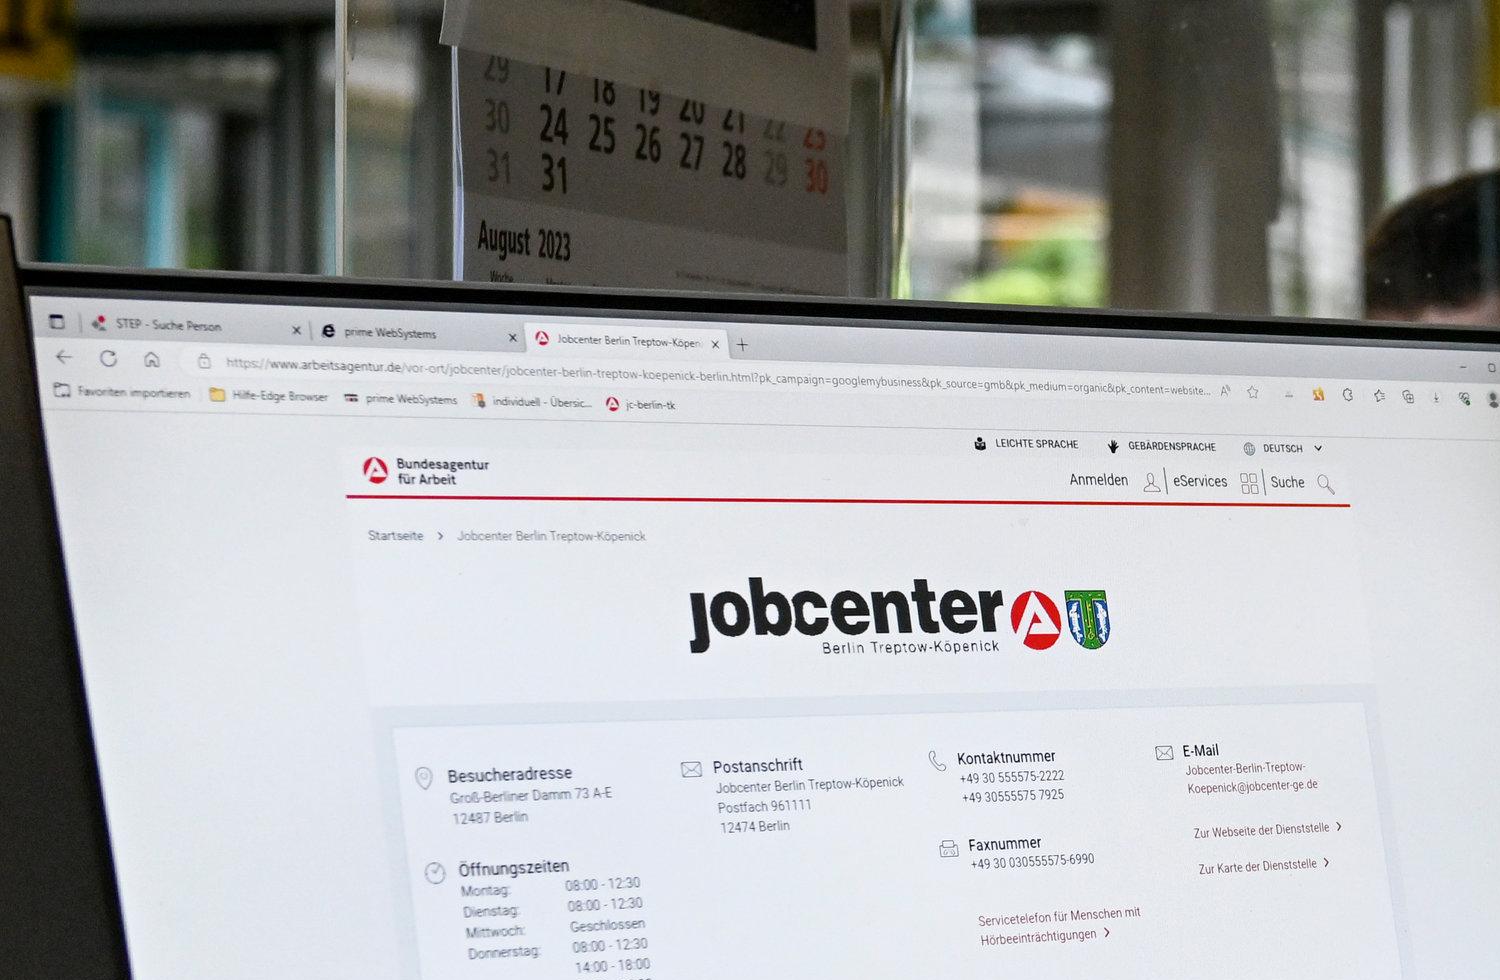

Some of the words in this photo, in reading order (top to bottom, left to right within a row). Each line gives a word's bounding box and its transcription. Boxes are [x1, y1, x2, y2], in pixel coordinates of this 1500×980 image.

[593, 78, 615, 106] 18
[485, 98, 509, 135] 30
[540, 103, 568, 145] 24
[589, 113, 616, 154] 25
[635, 123, 661, 163] 26
[680, 133, 704, 171] 27
[723, 141, 747, 181] 28
[764, 150, 788, 187] 29
[805, 157, 829, 194] 30
[488, 148, 511, 185] 31
[542, 153, 568, 194] 31
[478, 220, 530, 261] August
[539, 229, 571, 261] 2023
[116, 318, 141, 329] STEP
[153, 320, 183, 332] Suche
[186, 322, 222, 333] Person
[345, 326, 373, 338] prime
[376, 327, 437, 342] WebSystems
[558, 333, 601, 345] Jobcenter
[605, 335, 630, 346] Berlin
[78, 386, 127, 398] Favoriten
[130, 388, 191, 401] importieren
[233, 389, 287, 403] Hilfe-Edge
[289, 391, 328, 402] Browser
[367, 394, 393, 406] prime
[396, 394, 457, 407] WebSystems
[626, 400, 675, 412] jc-berlin-tk
[996, 438, 1034, 448] LEICHTE
[1036, 438, 1079, 449] SPRACHE
[1128, 439, 1216, 452] GEBÄRDENSPRACHE
[1264, 443, 1303, 453] DEUTSCH
[397, 458, 490, 471] Bundesagentur
[398, 473, 416, 485] für
[420, 474, 456, 485] Arbeit
[1069, 473, 1129, 486] Anmelden
[1174, 475, 1228, 488] eServices
[1271, 476, 1305, 489] Suche
[368, 529, 424, 541] Startseite
[457, 530, 513, 541] Jobcenter
[516, 530, 547, 541] Berlin
[550, 530, 646, 544] Treptow-Köpenick
[690, 577, 1003, 654] jobcenter
[822, 641, 865, 655] Berlin
[870, 640, 1000, 656] Treptow-Köpenick
[957, 750, 1056, 765] Kontaktnummer
[1183, 743, 1219, 757] E-Mail
[713, 757, 803, 774] Postanschrift
[1186, 761, 1306, 776] Jobcenter-Berlin-Treptow-
[448, 767, 573, 783] Besucheradresse
[960, 773, 980, 784] +49
[982, 772, 995, 783] 30
[998, 770, 1065, 783] 555575-2222
[716, 781, 771, 794] Jobcenter
[774, 780, 806, 792] Berlin
[807, 776, 905, 791] Treptow-Köpenick
[450, 790, 529, 804] Groß-Berliner
[532, 789, 572, 801] Damm
[575, 787, 590, 800] 73
[593, 786, 612, 799] A-E
[962, 792, 982, 803] +49
[985, 789, 1037, 802] 30555575
[1039, 788, 1064, 800] 7925
[718, 801, 769, 814] Postfach
[771, 799, 812, 812] 961111
[453, 812, 490, 825] 12487
[494, 811, 529, 824] Berlin
[720, 821, 755, 834] 12474
[759, 820, 790, 832] Berlin
[1194, 826, 1210, 839] Zur
[1212, 825, 1256, 837] Webseite
[1258, 824, 1274, 836] der
[1275, 822, 1330, 835] Dienststelle
[968, 837, 1042, 852] Faxnummer
[458, 860, 570, 878] Öffnungszeiten
[971, 858, 991, 870] +49
[993, 857, 1007, 869] 30
[1009, 853, 1095, 868] 030555575-6990
[1199, 862, 1214, 875] Zur
[1217, 862, 1243, 874] Karte
[1245, 860, 1260, 872] der
[1262, 858, 1317, 872] Dienststelle
[460, 884, 511, 898] Montag:
[565, 879, 599, 892] 08:00
[608, 876, 641, 890] 12:30
[567, 899, 601, 912] 08:00
[611, 897, 644, 910] 12:30
[978, 911, 1051, 927] Servicetelefon
[1054, 911, 1068, 923] für
[1070, 907, 1123, 922] Menschen
[1125, 905, 1141, 917] mit
[570, 918, 646, 933] Geschlossen
[980, 928, 1097, 946] Hörbeeinträchtigungen
[572, 940, 605, 954] 08:00
[615, 937, 648, 951] 12:30
[576, 960, 608, 974] 14:00
[618, 957, 651, 971] 18:00
